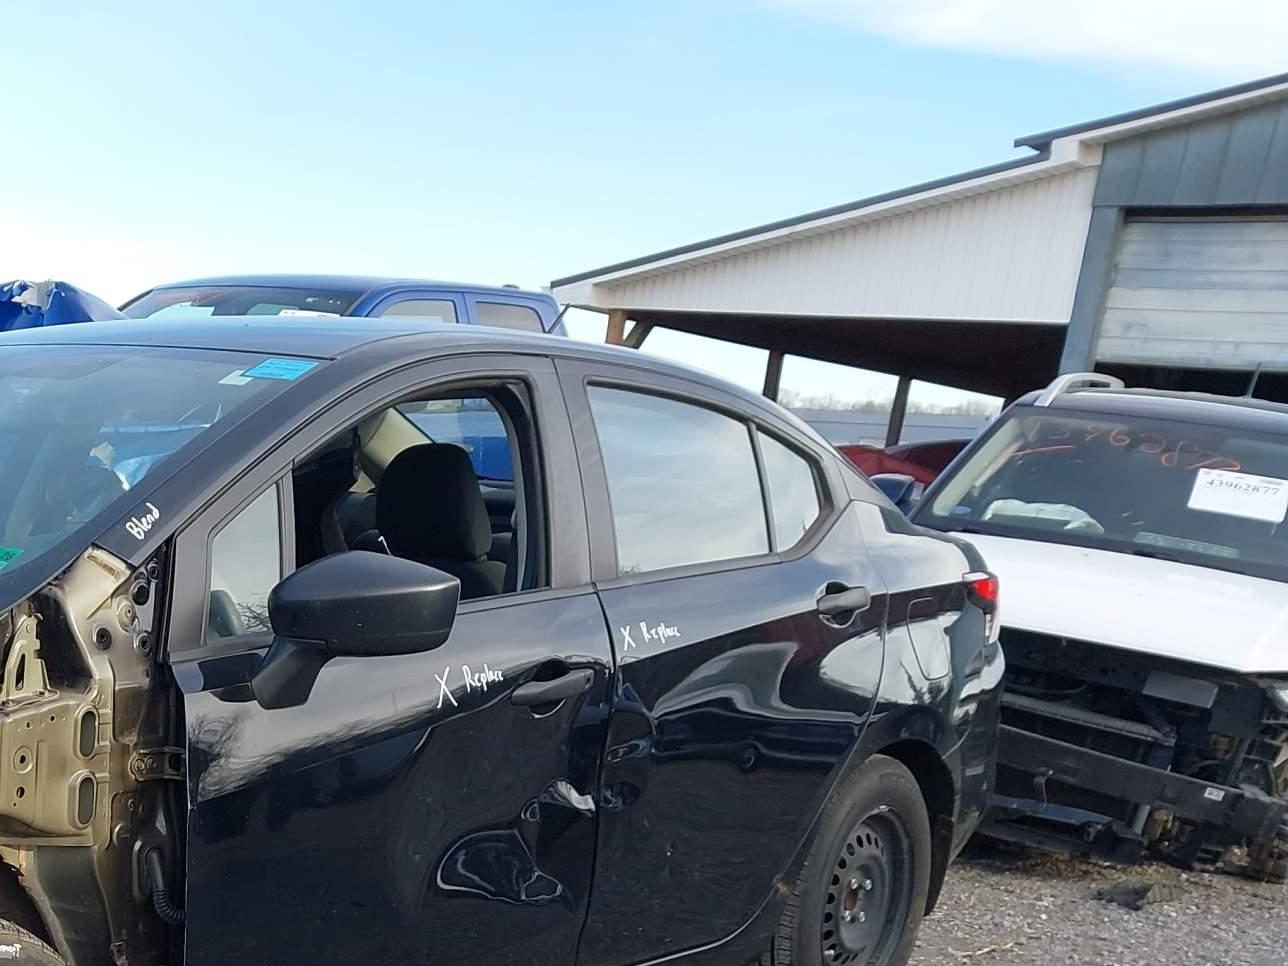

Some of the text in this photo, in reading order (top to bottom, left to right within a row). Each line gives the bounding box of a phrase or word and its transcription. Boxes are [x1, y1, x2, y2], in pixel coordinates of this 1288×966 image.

[125, 502, 160, 539] Blend
[619, 624, 637, 652] X
[433, 665, 459, 709] X
